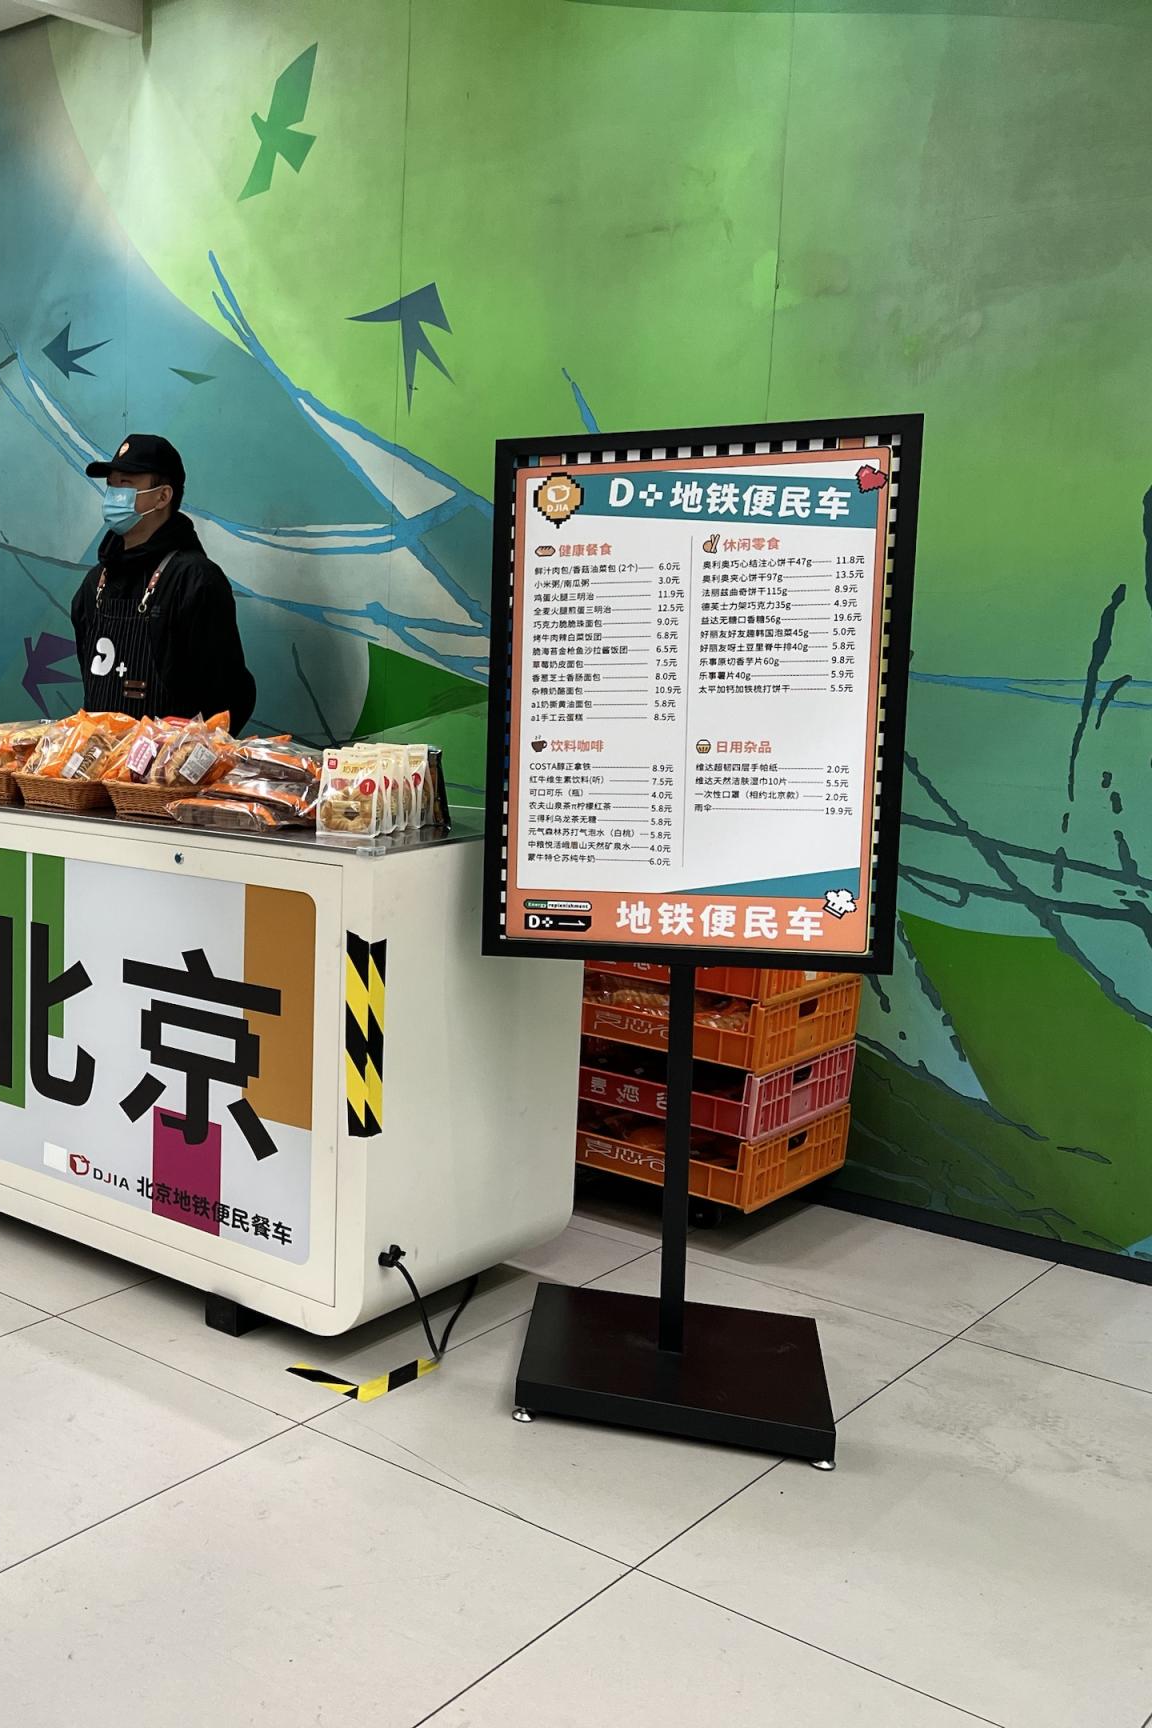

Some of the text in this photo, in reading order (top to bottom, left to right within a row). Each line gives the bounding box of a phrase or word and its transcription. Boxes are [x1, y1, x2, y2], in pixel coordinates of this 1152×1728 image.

[547, 504, 569, 513] DJIA
[559, 543, 612, 557] 健康餐食
[723, 537, 781, 552] 休闲零食
[836, 555, 865, 565] 11.8元
[659, 562, 680, 571] 6.0元
[702, 569, 864, 584] 奥利奥夹心饼干97g 13.5元
[534, 576, 680, 589] 小米粥/南瓜粥 3.0元
[534, 590, 685, 602] 鸡蛋火腿三明治 11.9元
[701, 584, 858, 598] 法丽兹曲奇饼干115g 8.9元
[534, 603, 684, 616] 全麦火腿煎蛋三明治 12.5元
[701, 598, 858, 612] 德芙士力架巧克力35g 4.9元
[533, 617, 679, 630] 巧克力脆脆珠面包 9.0元
[701, 613, 862, 625] 益达无糖口香糖56g 19.6元
[533, 631, 678, 643] 烤牛肉辣白菜饭团 6.8元
[700, 626, 856, 639] 好丽友好友趣韩国泡菜45g 5.0元
[532, 645, 678, 656] 脆海苔金枪鱼沙拉酱饭团 6.5元
[832, 641, 856, 650] 5.8元
[532, 658, 678, 669] 草莓奶皮面包 7.5元
[831, 655, 855, 664] 9.8元
[532, 671, 677, 683] 香葱芝士香肠面包 8.0元
[699, 669, 854, 681] 乐事薯片40g 5.9元
[532, 686, 682, 696] 杂粮奶酪面包 10.9元
[698, 683, 853, 694] 太平加钙加铁梳打饼干 5.5元
[654, 699, 676, 708] 5.8元
[530, 713, 676, 722] a1手工云蛋糕 8.5元
[550, 740, 605, 753] 饮料咖啡
[716, 741, 772, 754] 日用杂品
[529, 763, 674, 773] COSTA醇正拿铁 8.9元
[826, 765, 849, 774] 2.0元
[652, 777, 674, 786] 7.5元
[826, 779, 849, 788] 5.5元
[651, 791, 673, 800] 4.0元
[825, 793, 848, 802] 2.0元
[651, 804, 673, 813] 5.8元
[694, 804, 853, 816] 雨伞 19.9元
[528, 815, 672, 826] 三得利乌龙茶无糖 5.8元
[650, 831, 672, 840] 5.8元
[650, 844, 671, 853] 4.0元
[528, 854, 671, 866] 蒙牛特仑苏纯牛奶 6.0元
[616, 901, 823, 942] 地铁便民车
[93, 1167, 294, 1246] DJIA 北京地铁便民餐车
